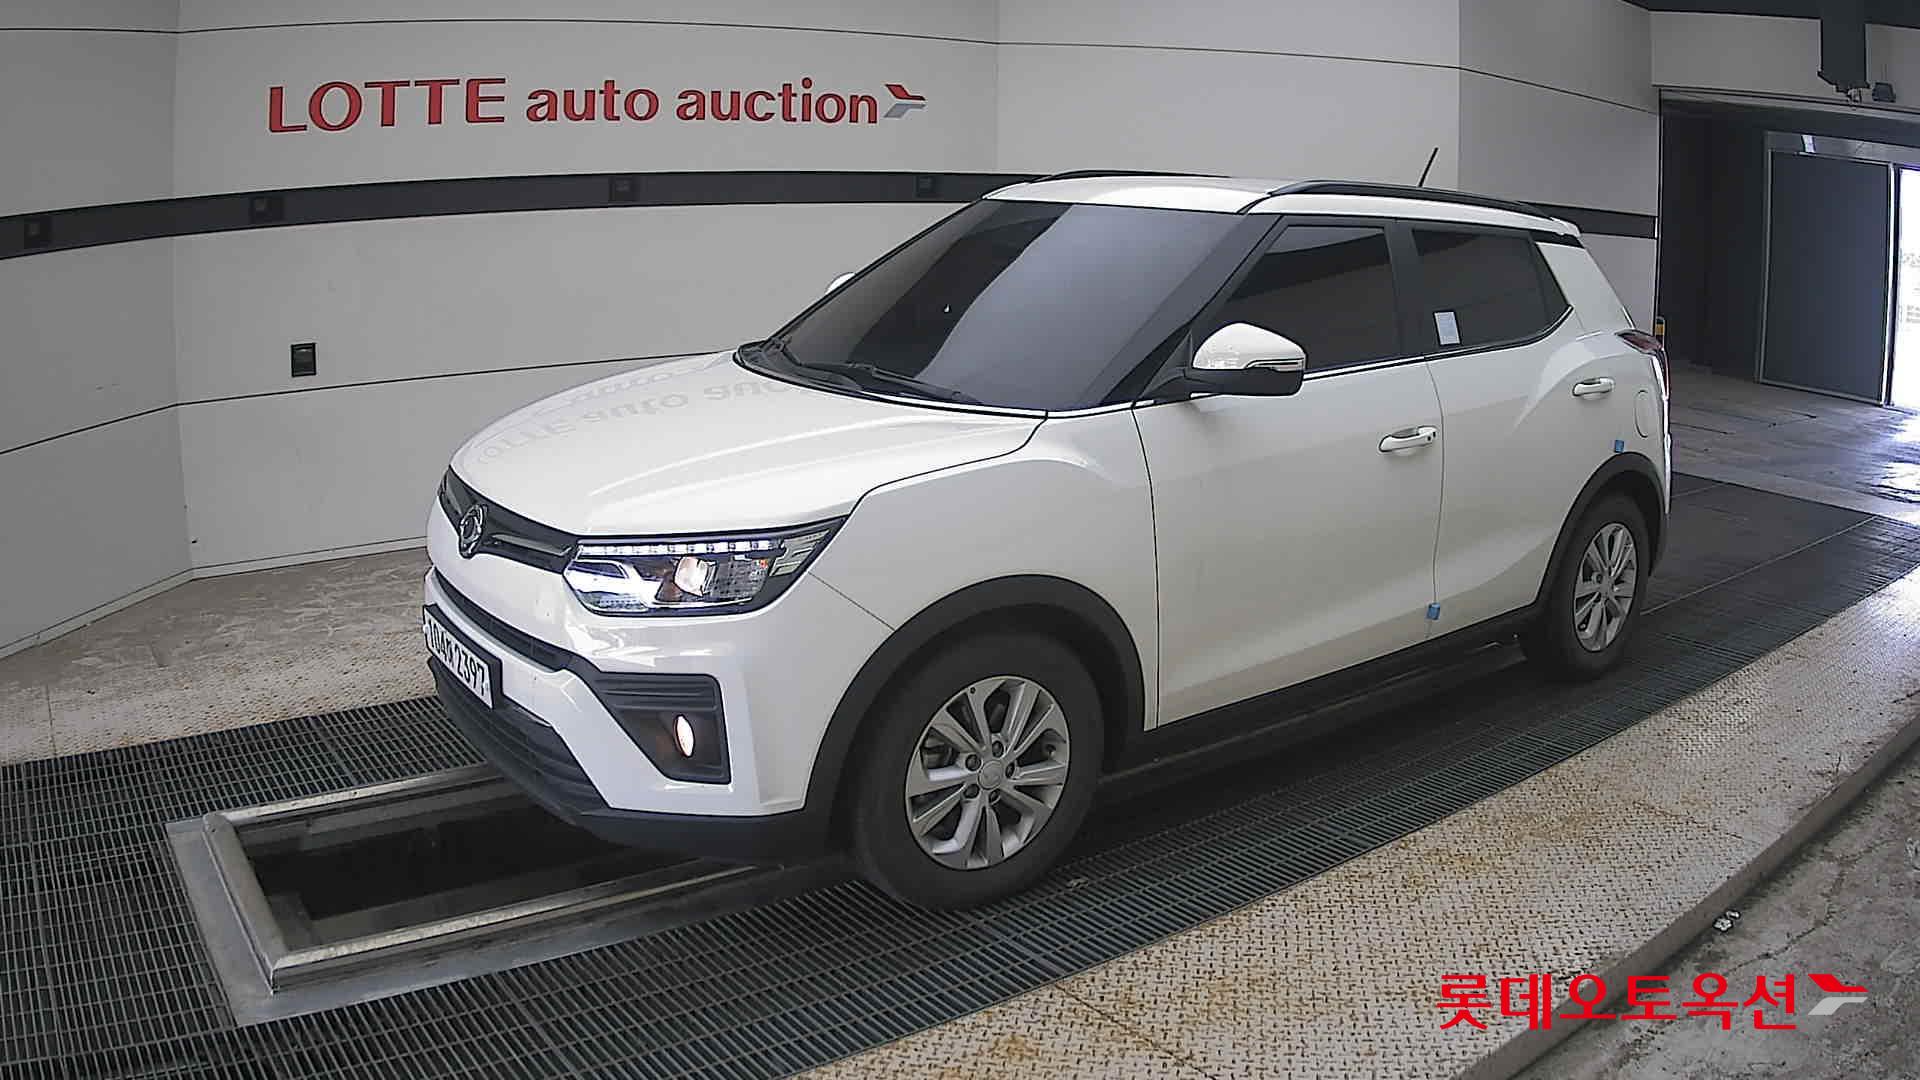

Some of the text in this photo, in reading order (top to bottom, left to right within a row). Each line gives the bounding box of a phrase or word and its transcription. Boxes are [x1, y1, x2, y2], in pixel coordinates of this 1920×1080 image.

[268, 78, 879, 133] LOTTE auto auction
[455, 643, 486, 697] 2397
